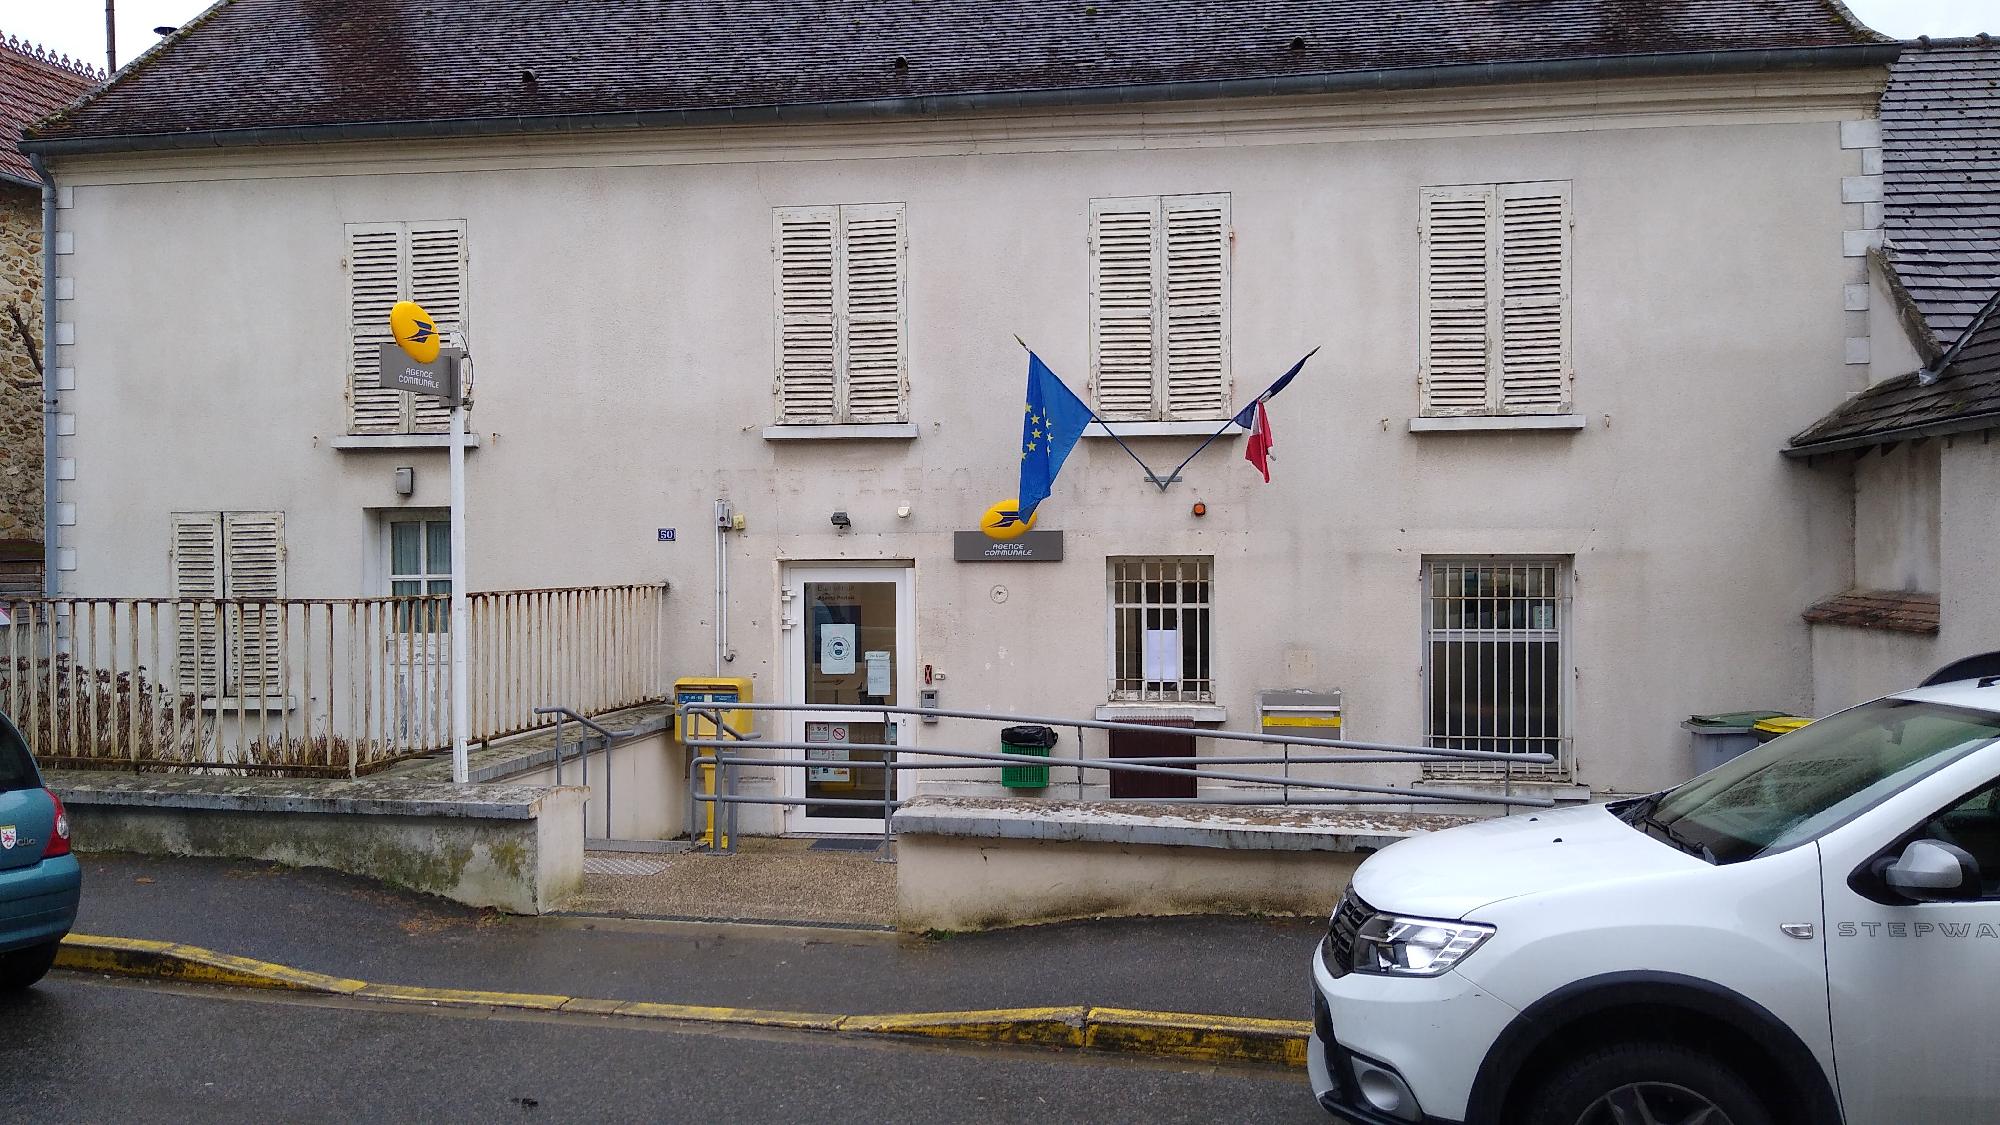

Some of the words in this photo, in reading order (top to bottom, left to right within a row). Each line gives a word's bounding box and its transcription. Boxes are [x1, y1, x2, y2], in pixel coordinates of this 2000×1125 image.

[405, 367, 433, 379] AGENCE
[398, 374, 440, 389] COMMUNALE
[1837, 921, 2000, 939] STEPWA
